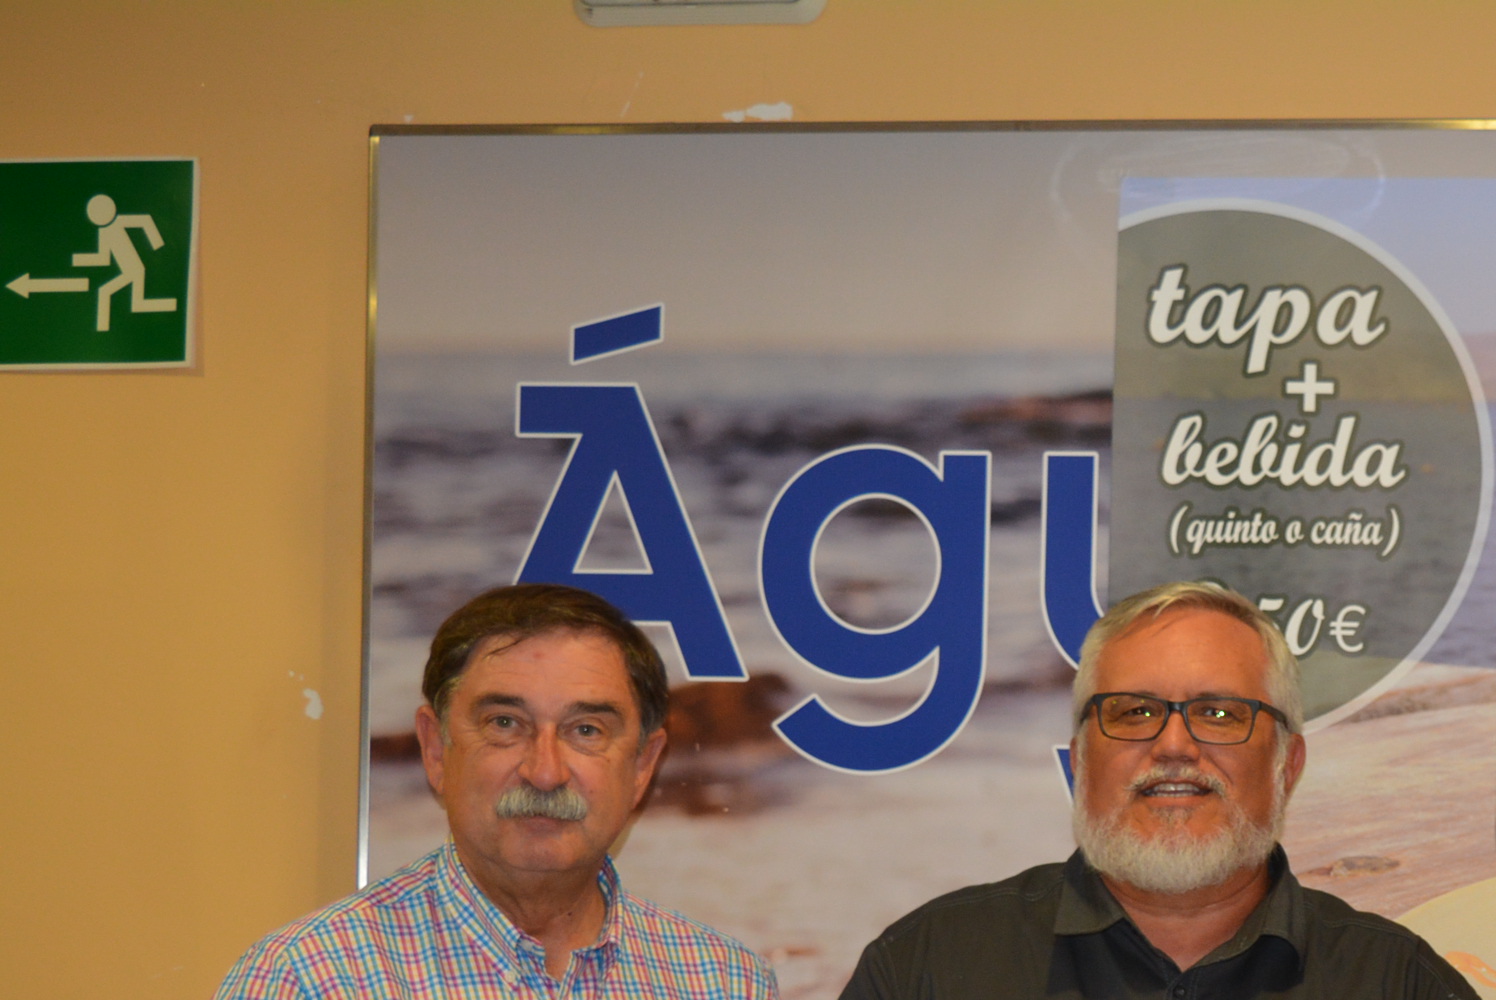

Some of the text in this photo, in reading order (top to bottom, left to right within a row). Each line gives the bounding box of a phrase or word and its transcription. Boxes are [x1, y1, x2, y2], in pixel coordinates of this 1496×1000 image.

[1147, 266, 1386, 373] tapa
[1285, 363, 1334, 411] +
[1161, 415, 1405, 488] bebida
[1169, 505, 1400, 556] (quinto o caña)
